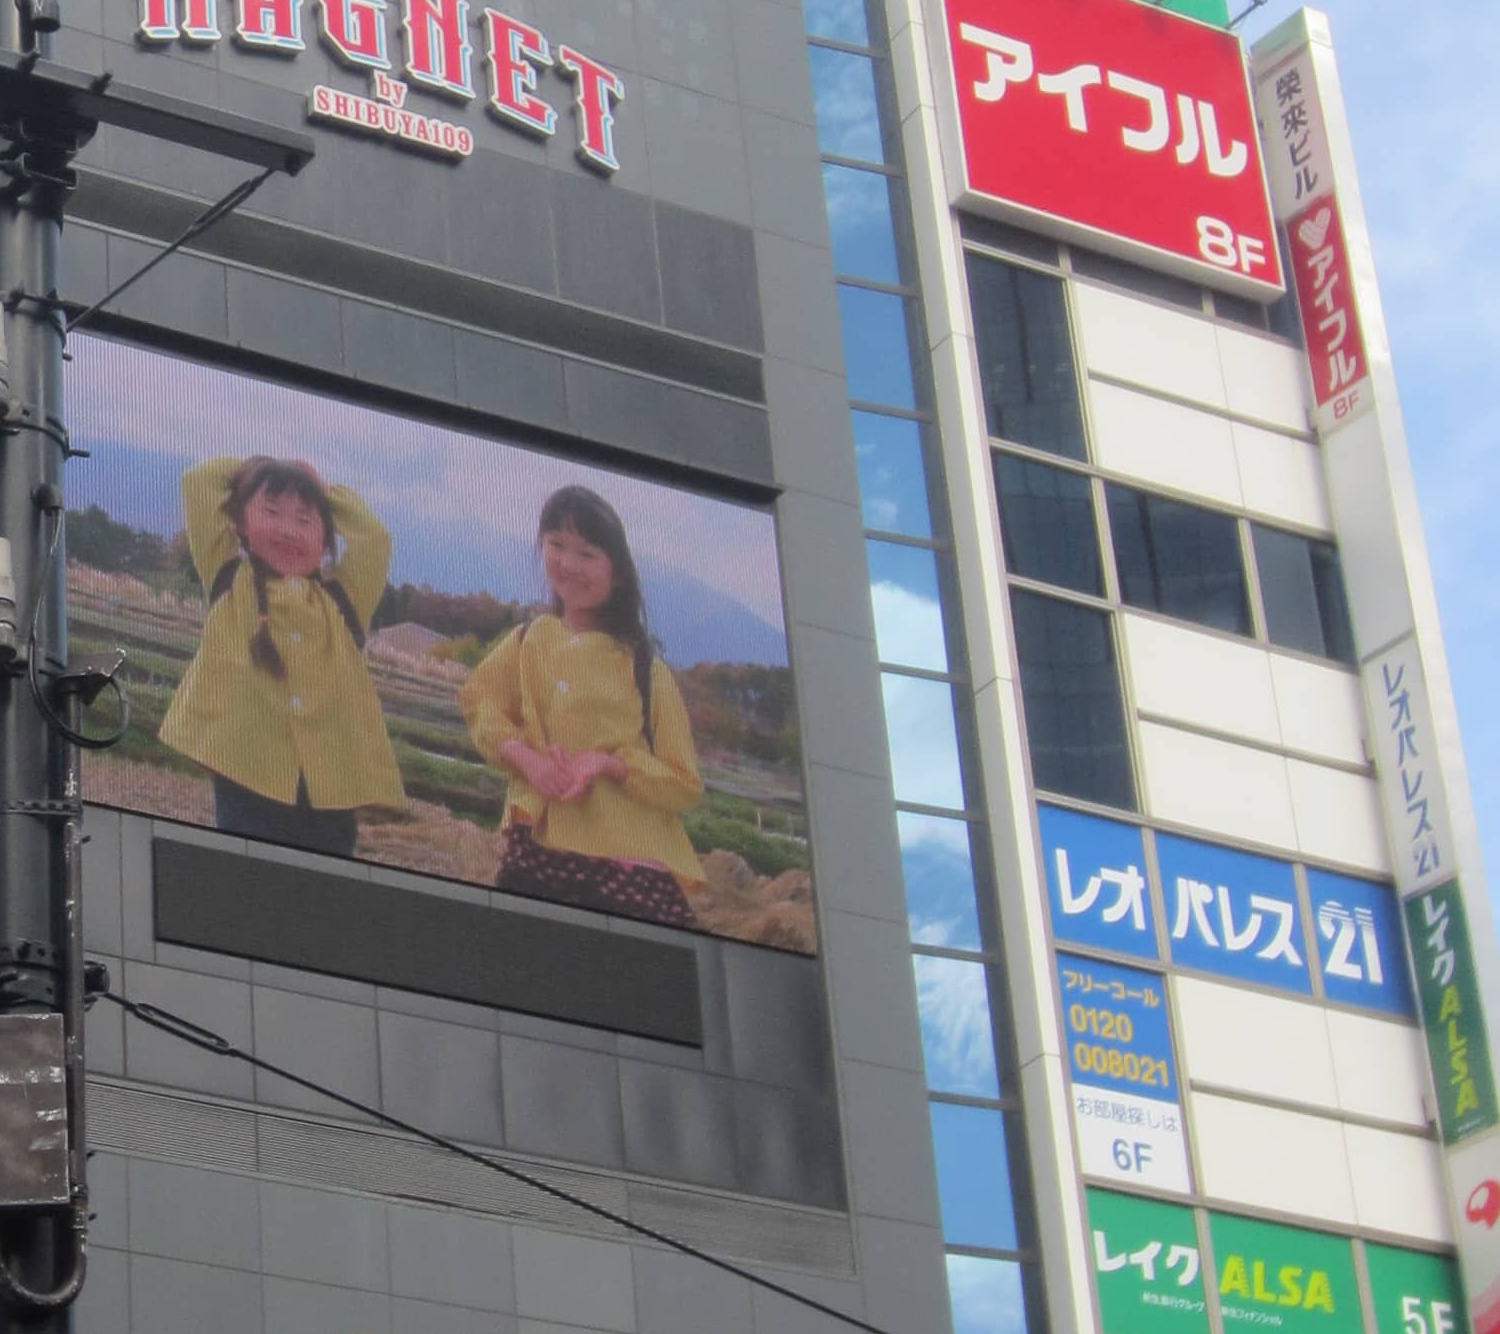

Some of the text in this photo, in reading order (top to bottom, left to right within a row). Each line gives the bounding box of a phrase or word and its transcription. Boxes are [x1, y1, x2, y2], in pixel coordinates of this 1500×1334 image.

[377, 73, 407, 106] by
[959, 21, 1248, 179] アイフル
[312, 84, 474, 156] SHIBUYA109
[1196, 214, 1266, 272] 8F
[1307, 245, 1357, 392] アイフル
[1332, 394, 1360, 420] 8F
[1062, 970, 1160, 1008] フリーコール
[1070, 1003, 1134, 1043] 0120
[1074, 1042, 1170, 1088] 008021
[1112, 1138, 1153, 1173] 6F
[1093, 1230, 1335, 1314] レイク ALSA
